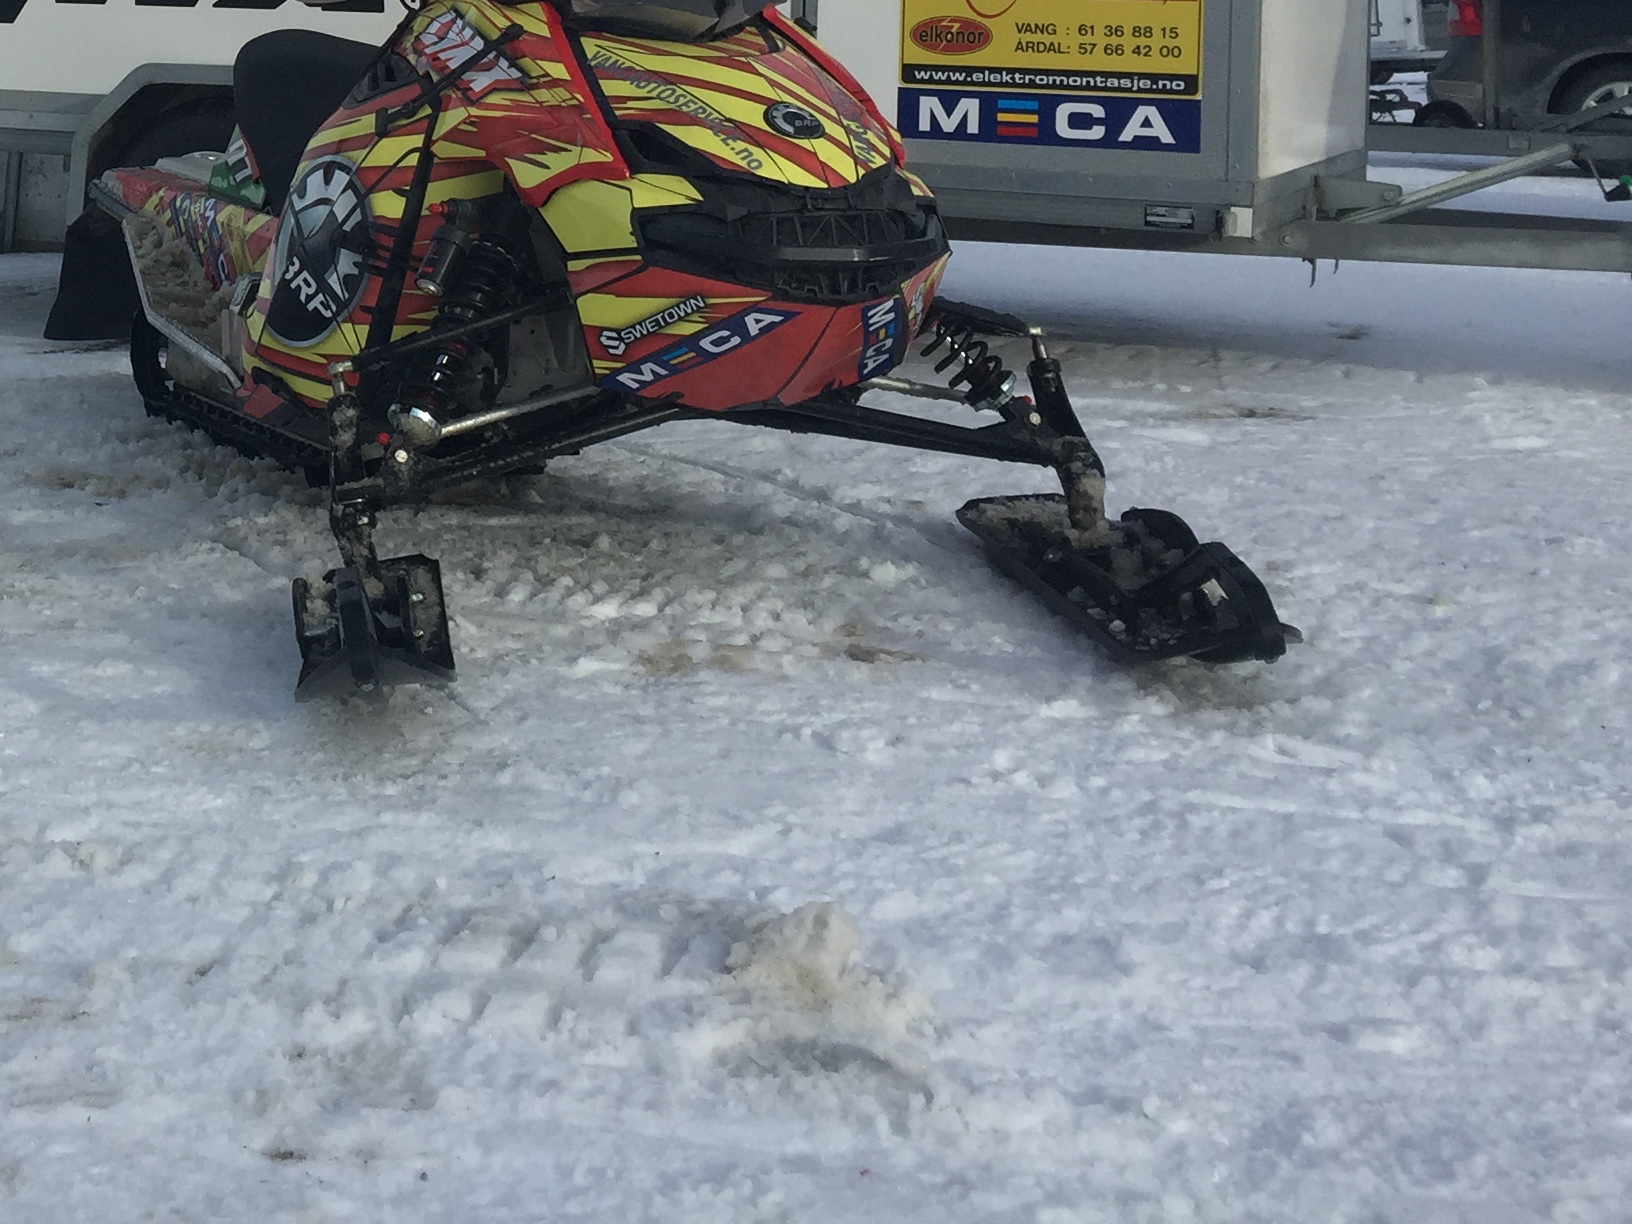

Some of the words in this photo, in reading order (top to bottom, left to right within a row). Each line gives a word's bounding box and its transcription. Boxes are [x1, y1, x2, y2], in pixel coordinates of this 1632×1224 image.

[918, 26, 985, 45] elkonor
[1015, 22, 1057, 36] VANG
[1077, 24, 1095, 37] 61
[1103, 25, 1125, 38] 36
[1131, 25, 1154, 39] 88
[1160, 26, 1179, 39] 15
[1077, 42, 1097, 56] 57
[1103, 43, 1125, 56] 66
[1131, 44, 1153, 58] 42
[1159, 45, 1183, 59] 00
[914, 69, 1185, 90] www.elektromontasje.no
[621, 294, 706, 343] SWETOWN
